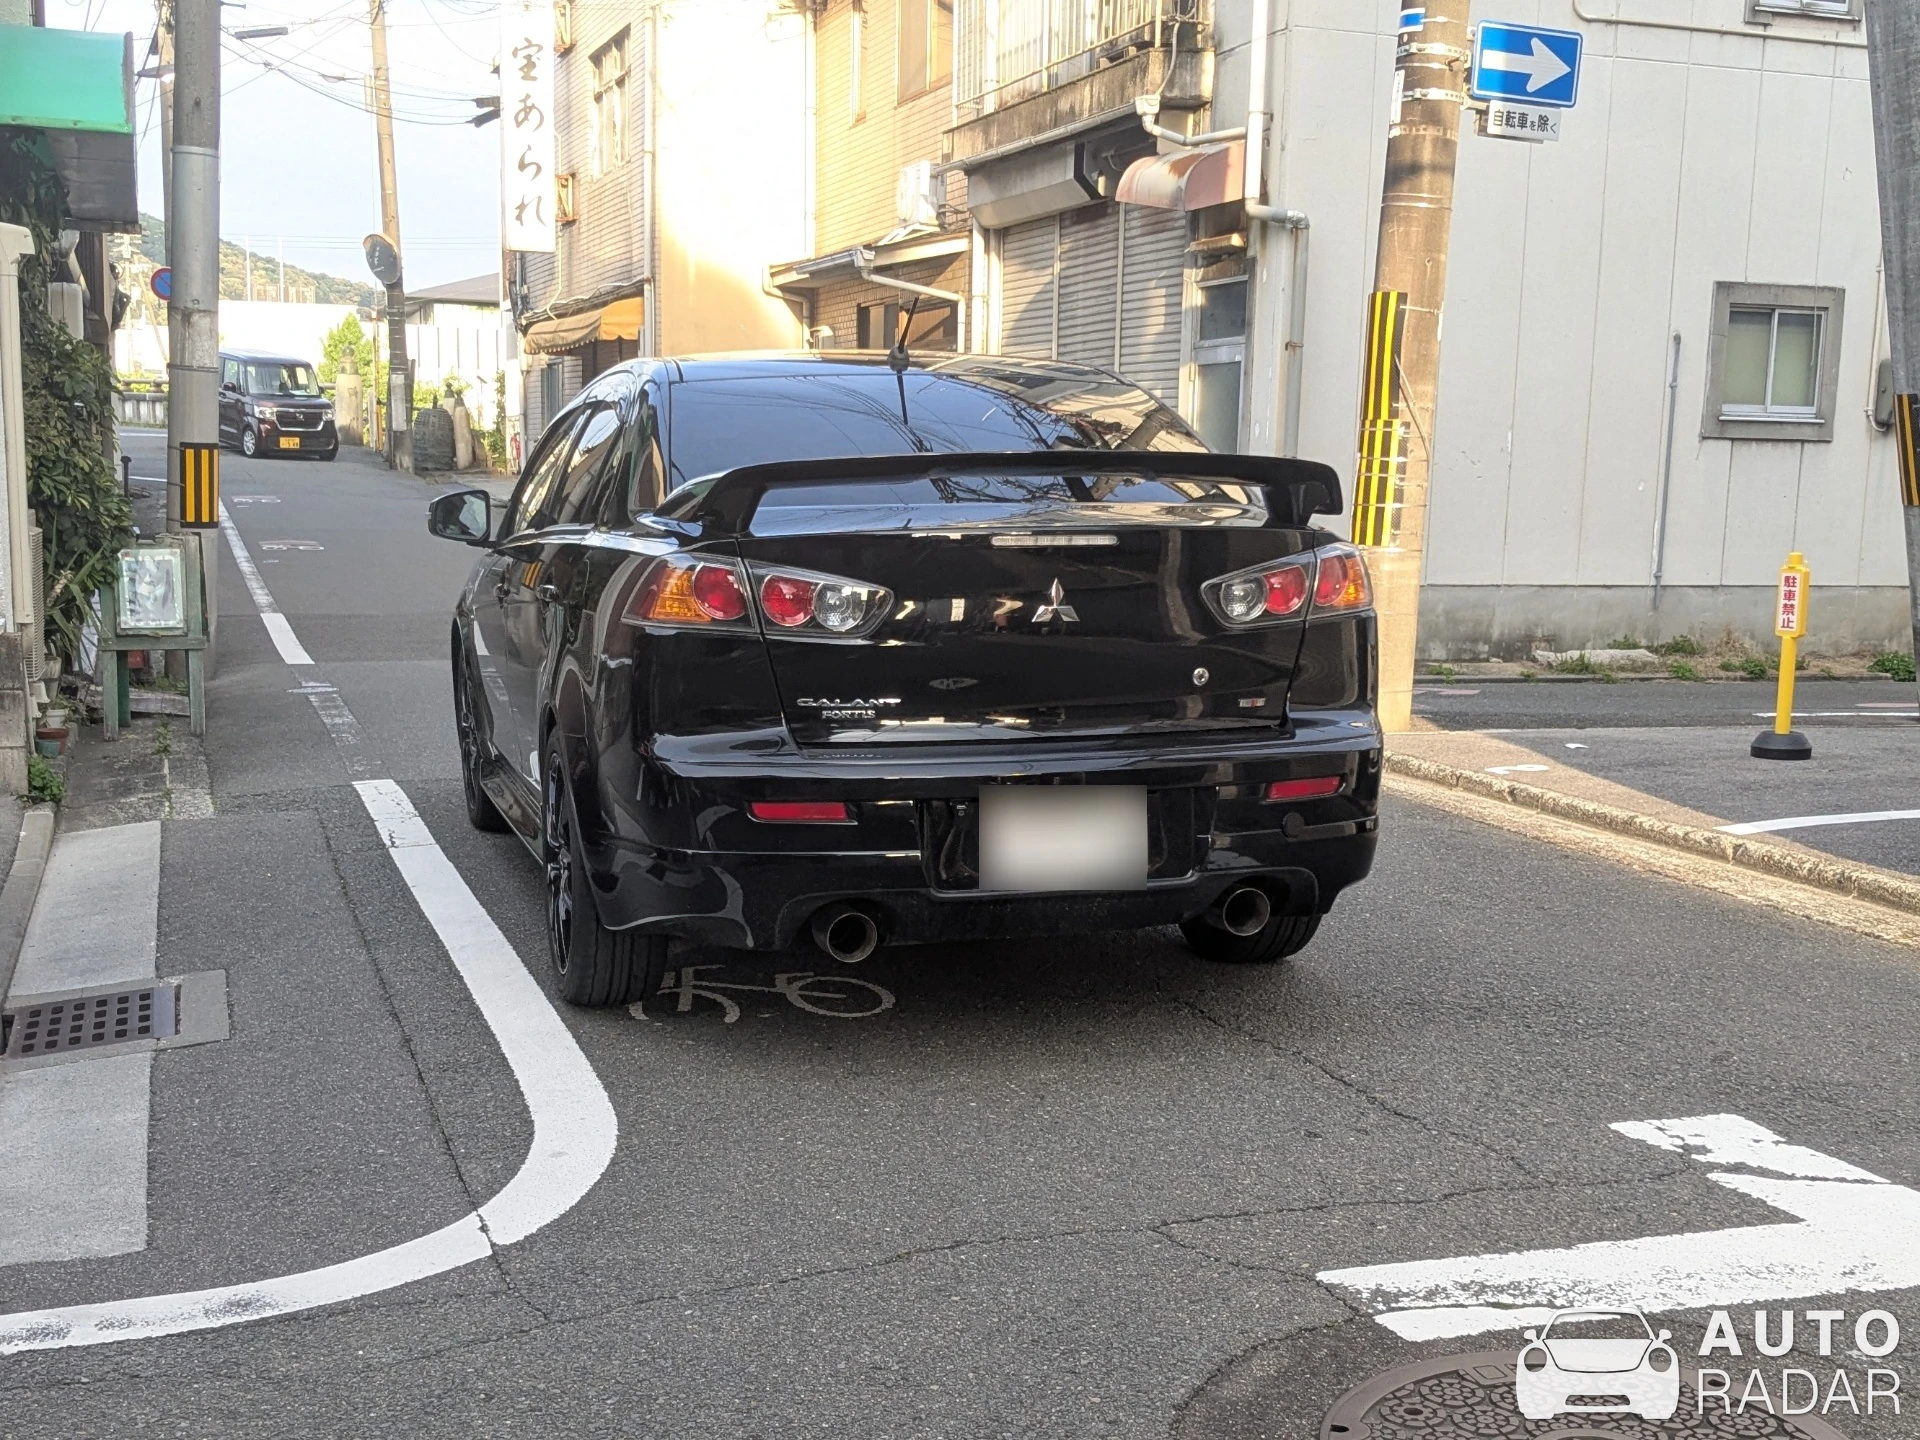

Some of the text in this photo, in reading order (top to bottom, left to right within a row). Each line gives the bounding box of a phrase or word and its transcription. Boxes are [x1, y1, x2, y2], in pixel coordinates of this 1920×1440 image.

[511, 37, 547, 227] 宝あられ
[1493, 109, 1557, 134] 自転車を除く
[1781, 575, 1798, 629] 駐車禁止
[796, 698, 902, 707] GALANT
[821, 710, 876, 719] FORTIS
